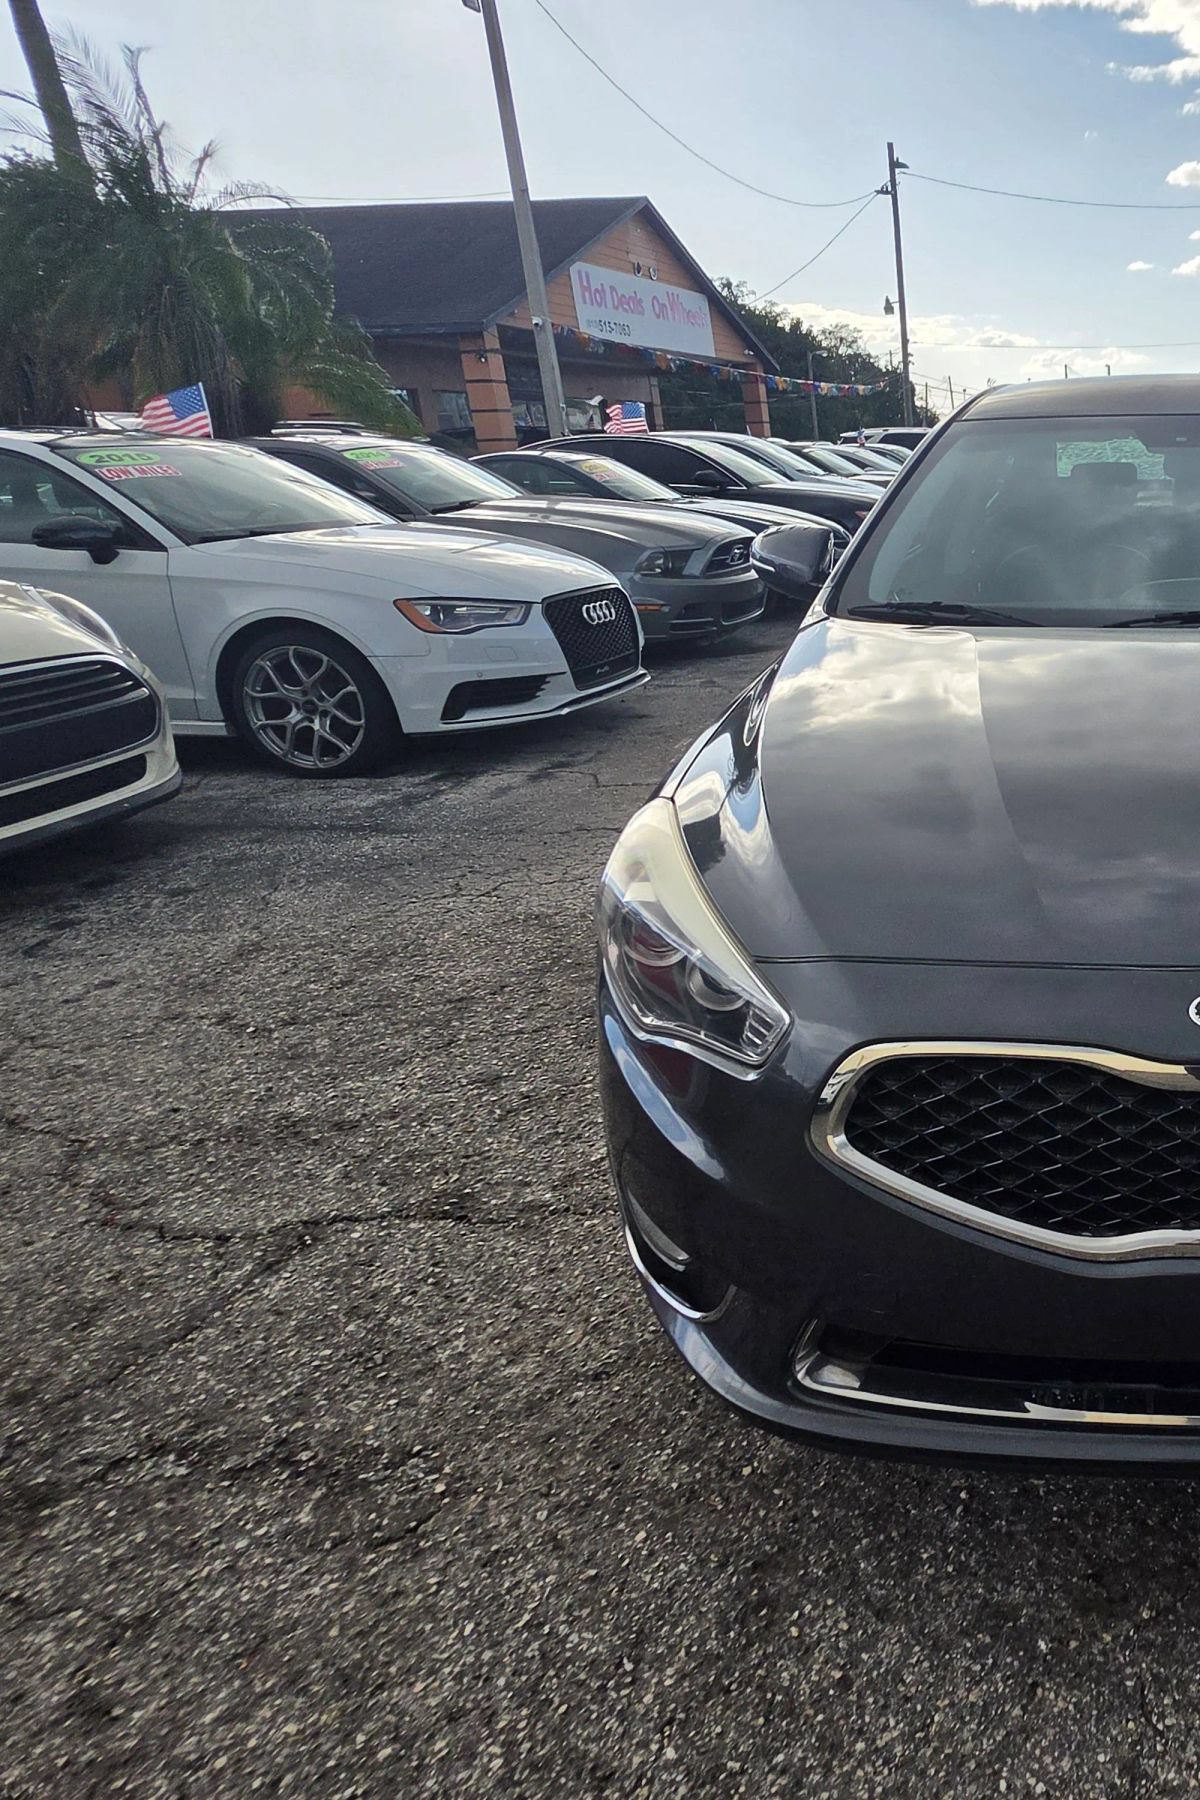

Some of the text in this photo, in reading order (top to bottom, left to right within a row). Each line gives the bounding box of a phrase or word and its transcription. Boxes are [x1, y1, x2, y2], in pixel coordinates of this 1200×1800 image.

[577, 269, 607, 309] Hot
[609, 286, 645, 316] Deals
[651, 295, 668, 320] On
[97, 466, 133, 480] LOW
